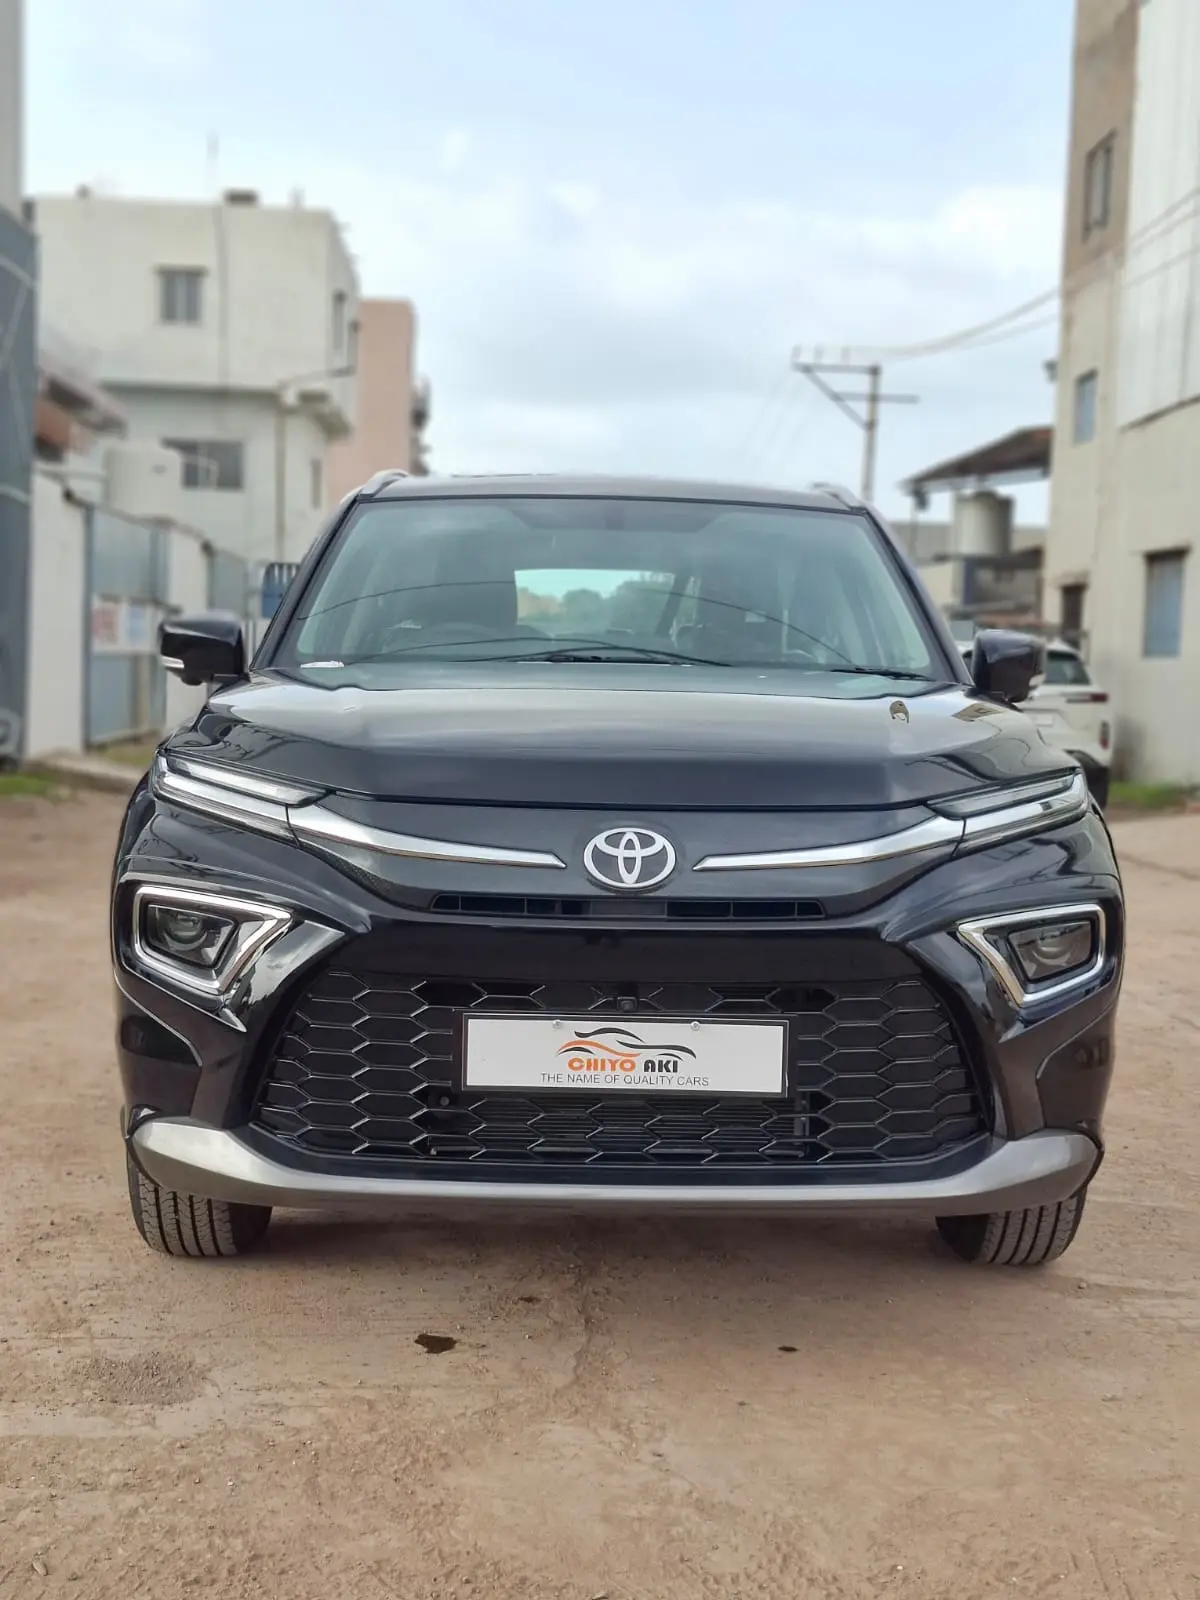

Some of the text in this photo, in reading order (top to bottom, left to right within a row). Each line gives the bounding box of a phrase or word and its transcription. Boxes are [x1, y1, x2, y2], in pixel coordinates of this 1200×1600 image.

[568, 1058, 678, 1073] CHIYO AKI
[541, 1072, 709, 1087] THE NAME OF QUALITY CARS
